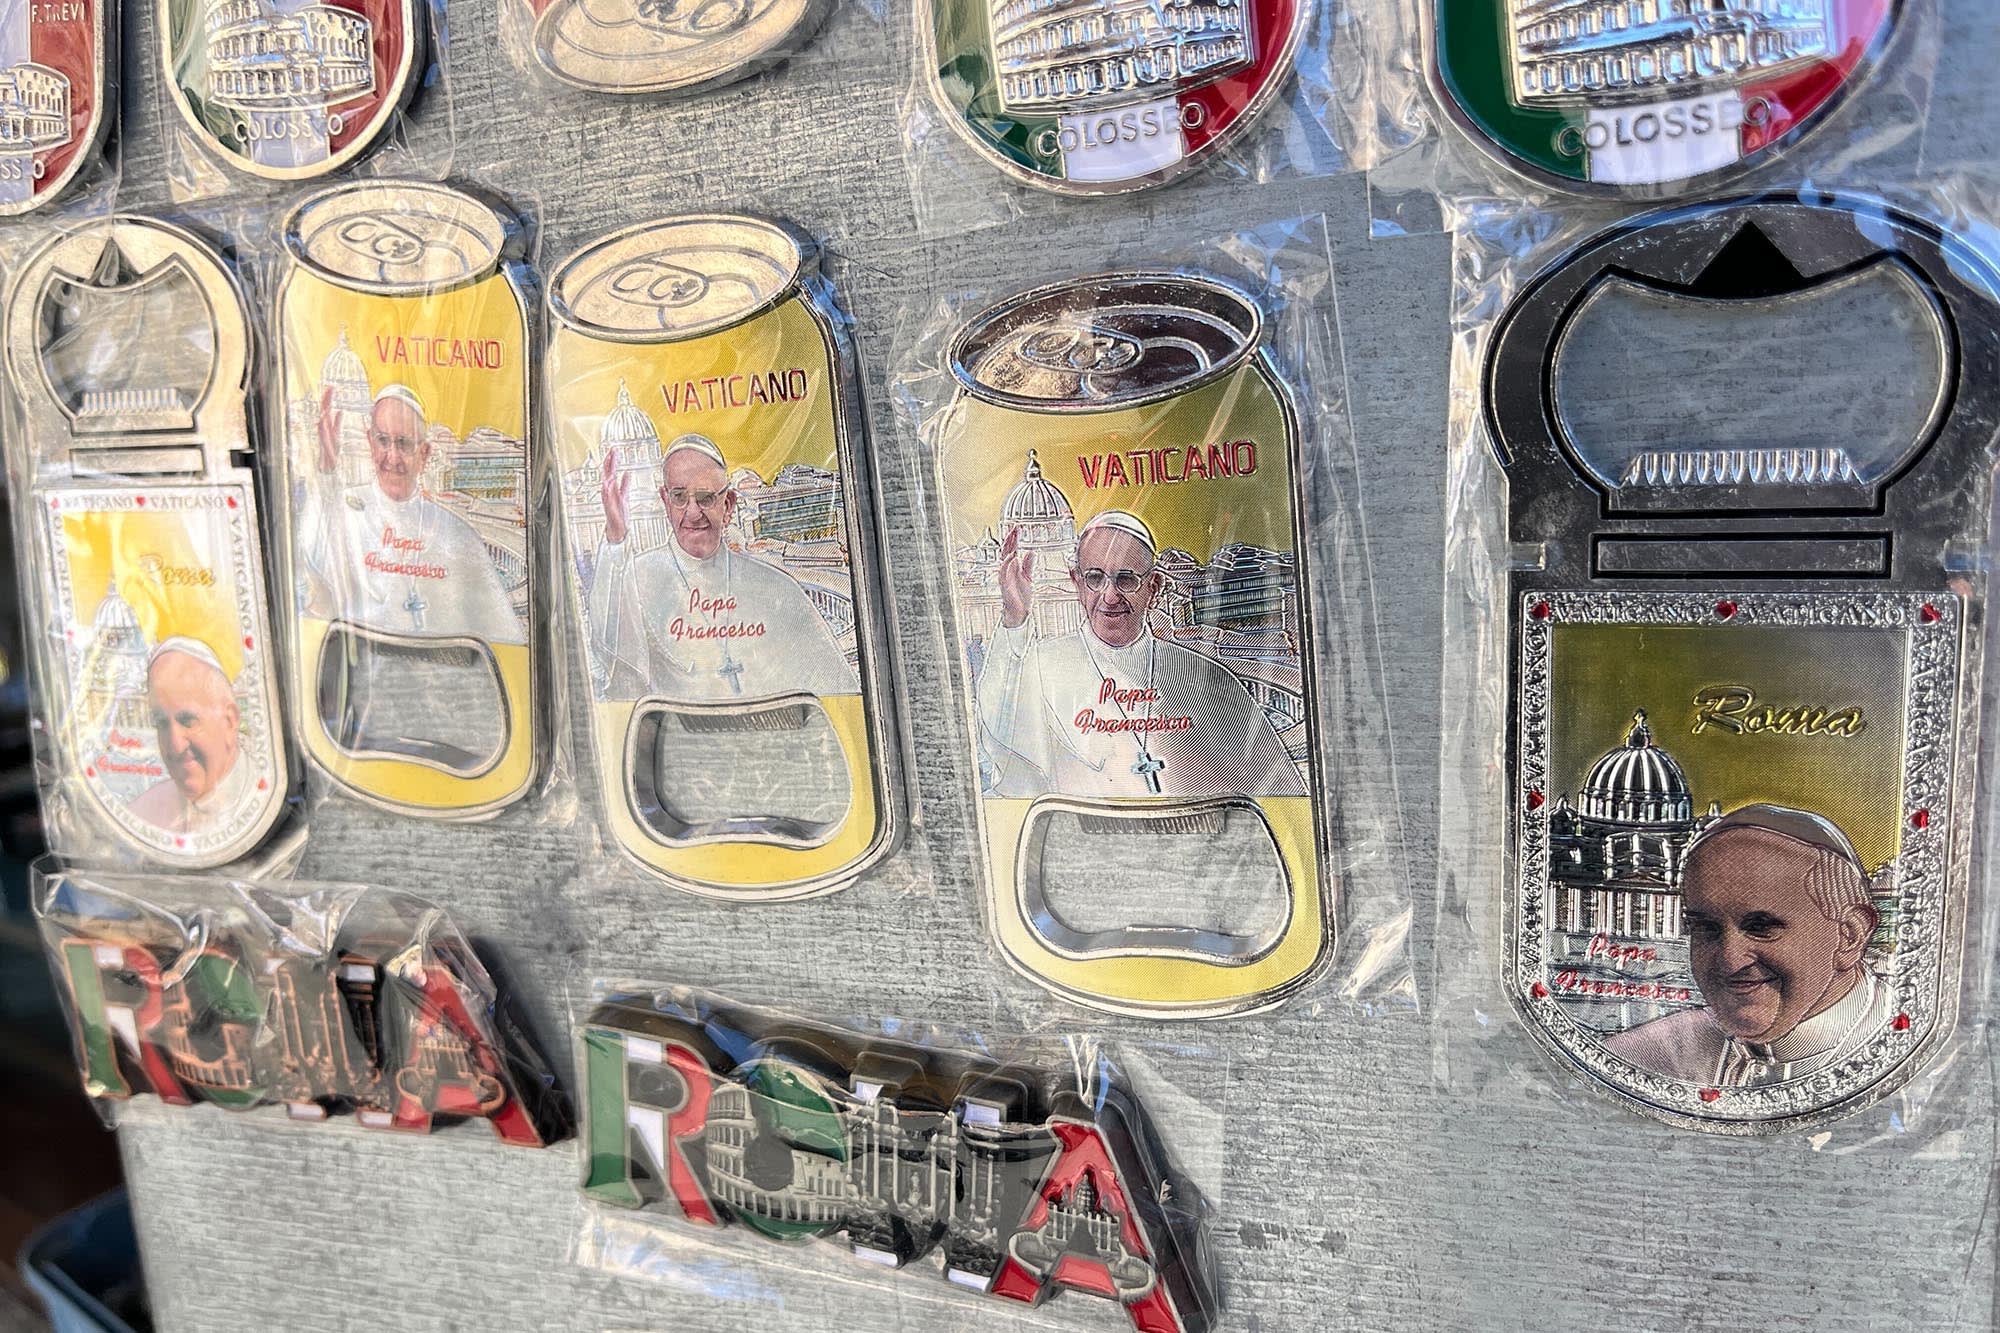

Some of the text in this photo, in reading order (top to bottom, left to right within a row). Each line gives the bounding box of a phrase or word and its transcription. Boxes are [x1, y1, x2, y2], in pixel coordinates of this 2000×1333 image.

[234, 113, 344, 143] COLOSSO
[1036, 101, 1206, 157] COLOSSEO
[1558, 95, 1772, 158] COLOSSEO
[375, 335, 506, 370] VATICANO
[660, 367, 809, 415] VATICANO
[1077, 438, 1259, 490] VATICANO
[687, 588, 738, 615] Papa
[669, 616, 768, 643] Francesco
[1099, 677, 1161, 712] Papa
[1690, 685, 1866, 739] Roma
[1073, 708, 1194, 735] Francesco
[1586, 931, 1659, 969] Papa
